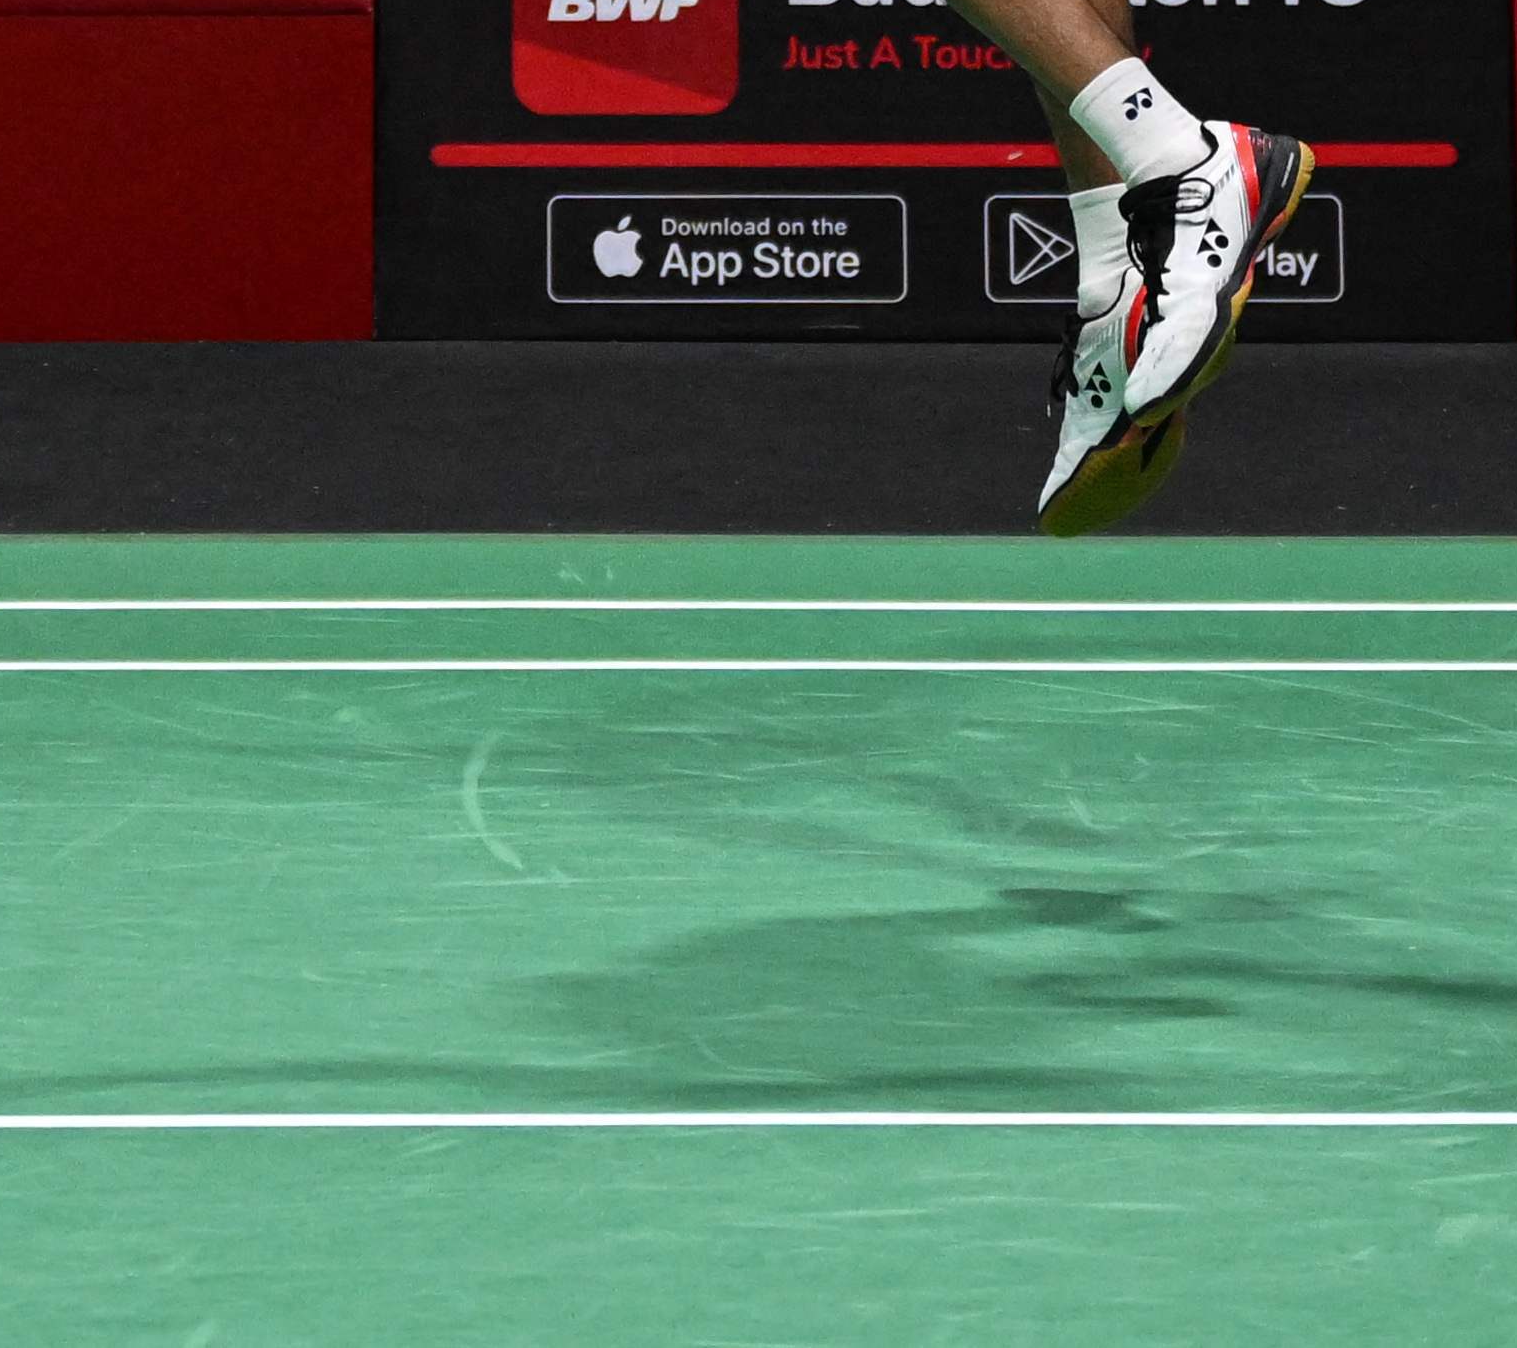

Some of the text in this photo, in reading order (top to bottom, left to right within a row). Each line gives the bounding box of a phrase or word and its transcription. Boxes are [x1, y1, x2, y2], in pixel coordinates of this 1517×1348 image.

[784, 35, 1012, 71] Just A Touc
[660, 217, 848, 236] Download on the
[658, 241, 861, 287] App Store
